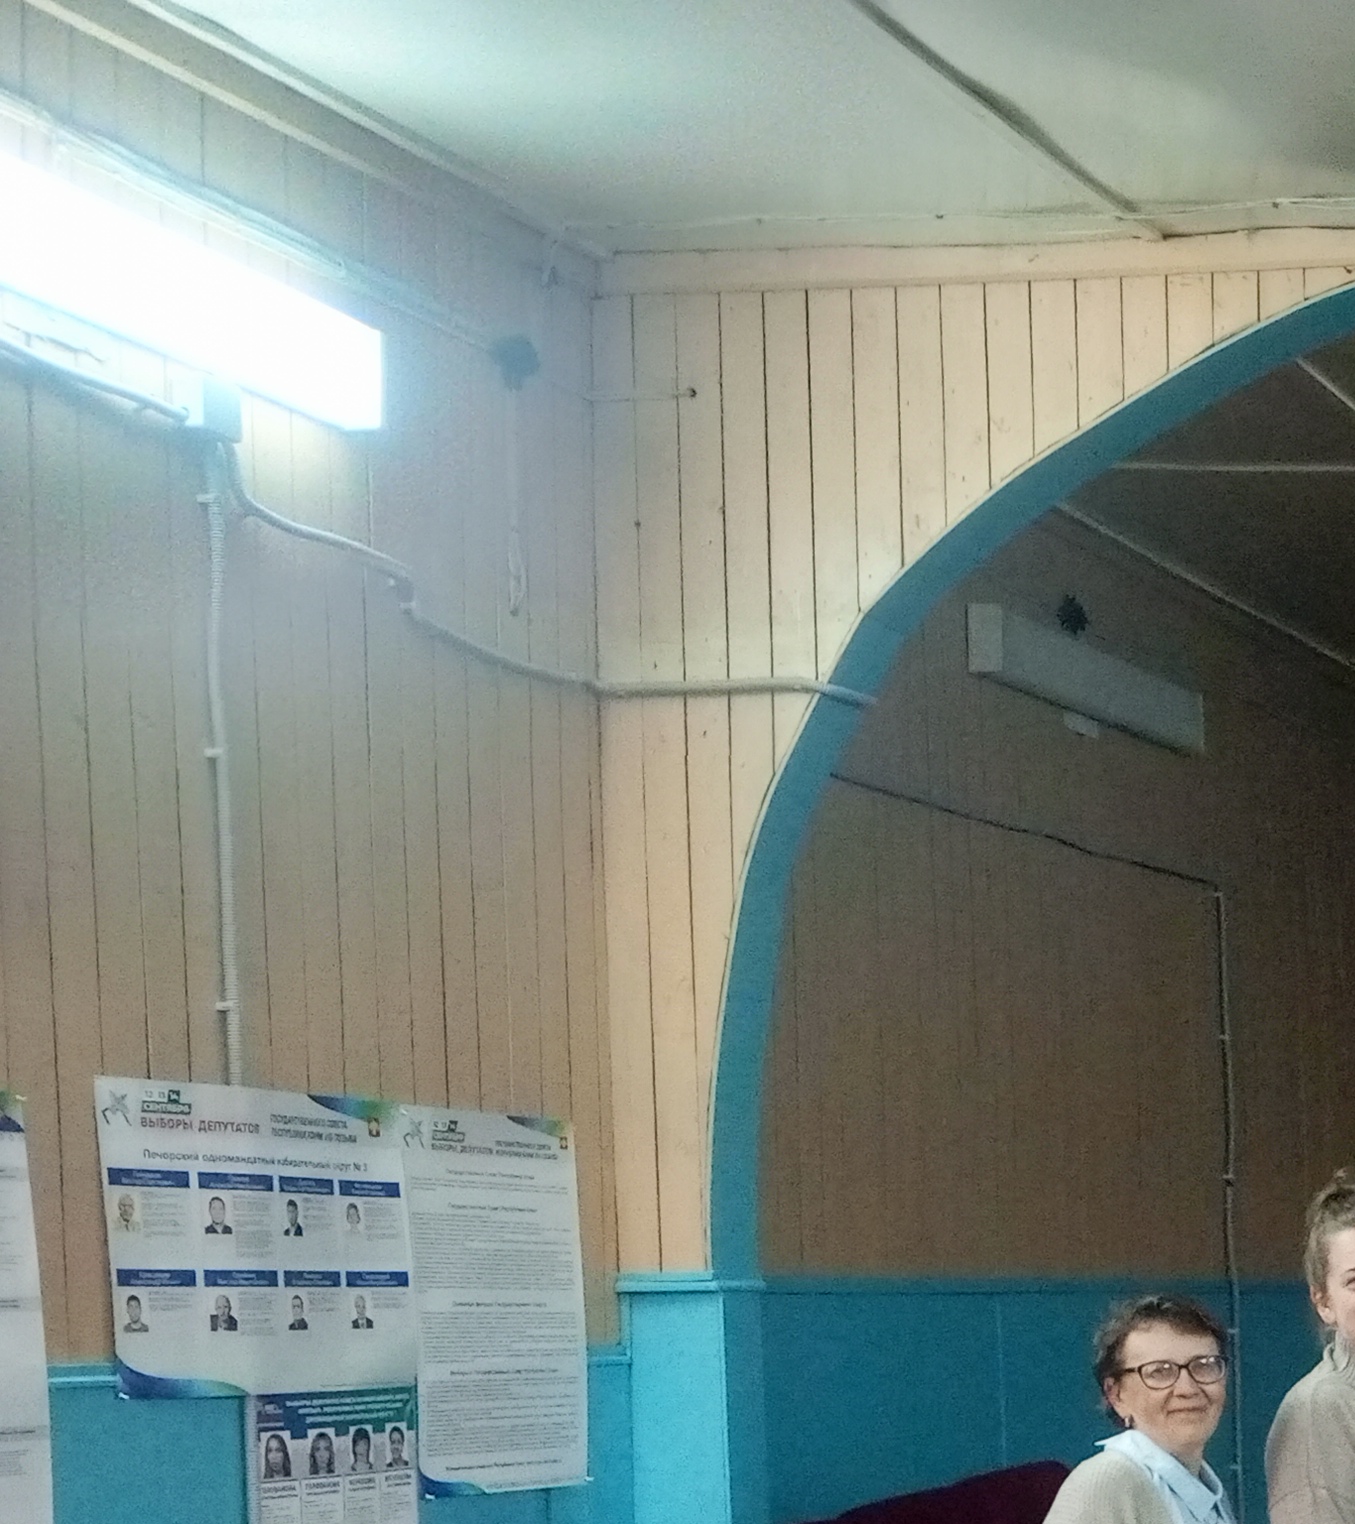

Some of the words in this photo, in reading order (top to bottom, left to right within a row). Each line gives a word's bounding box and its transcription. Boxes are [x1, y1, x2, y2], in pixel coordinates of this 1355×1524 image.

[140, 1117, 193, 1131] ВЫБОРЫ
[198, 1119, 260, 1134] ДЕПУТАТОВ
[143, 1148, 200, 1162] Печорский
